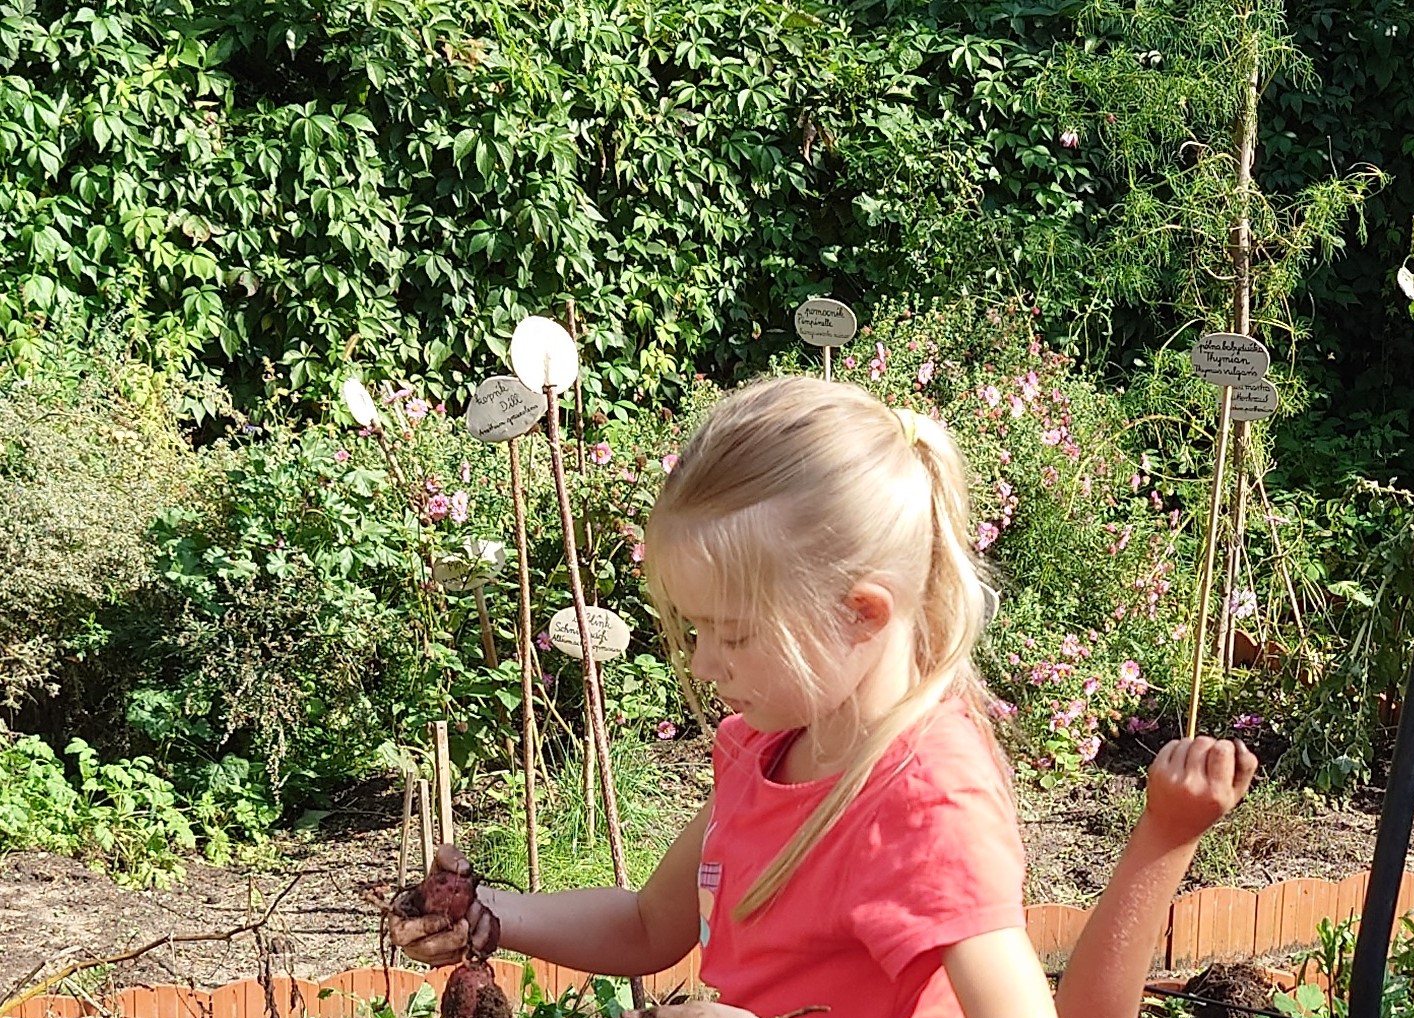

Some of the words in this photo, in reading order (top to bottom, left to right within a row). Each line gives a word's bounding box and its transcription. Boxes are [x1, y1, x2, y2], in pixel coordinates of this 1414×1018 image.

[1203, 351, 1251, 367] Thymian
[1193, 364, 1222, 378] Thymus
[1222, 366, 1258, 380] vulgaris
[500, 393, 523, 412] Dill
